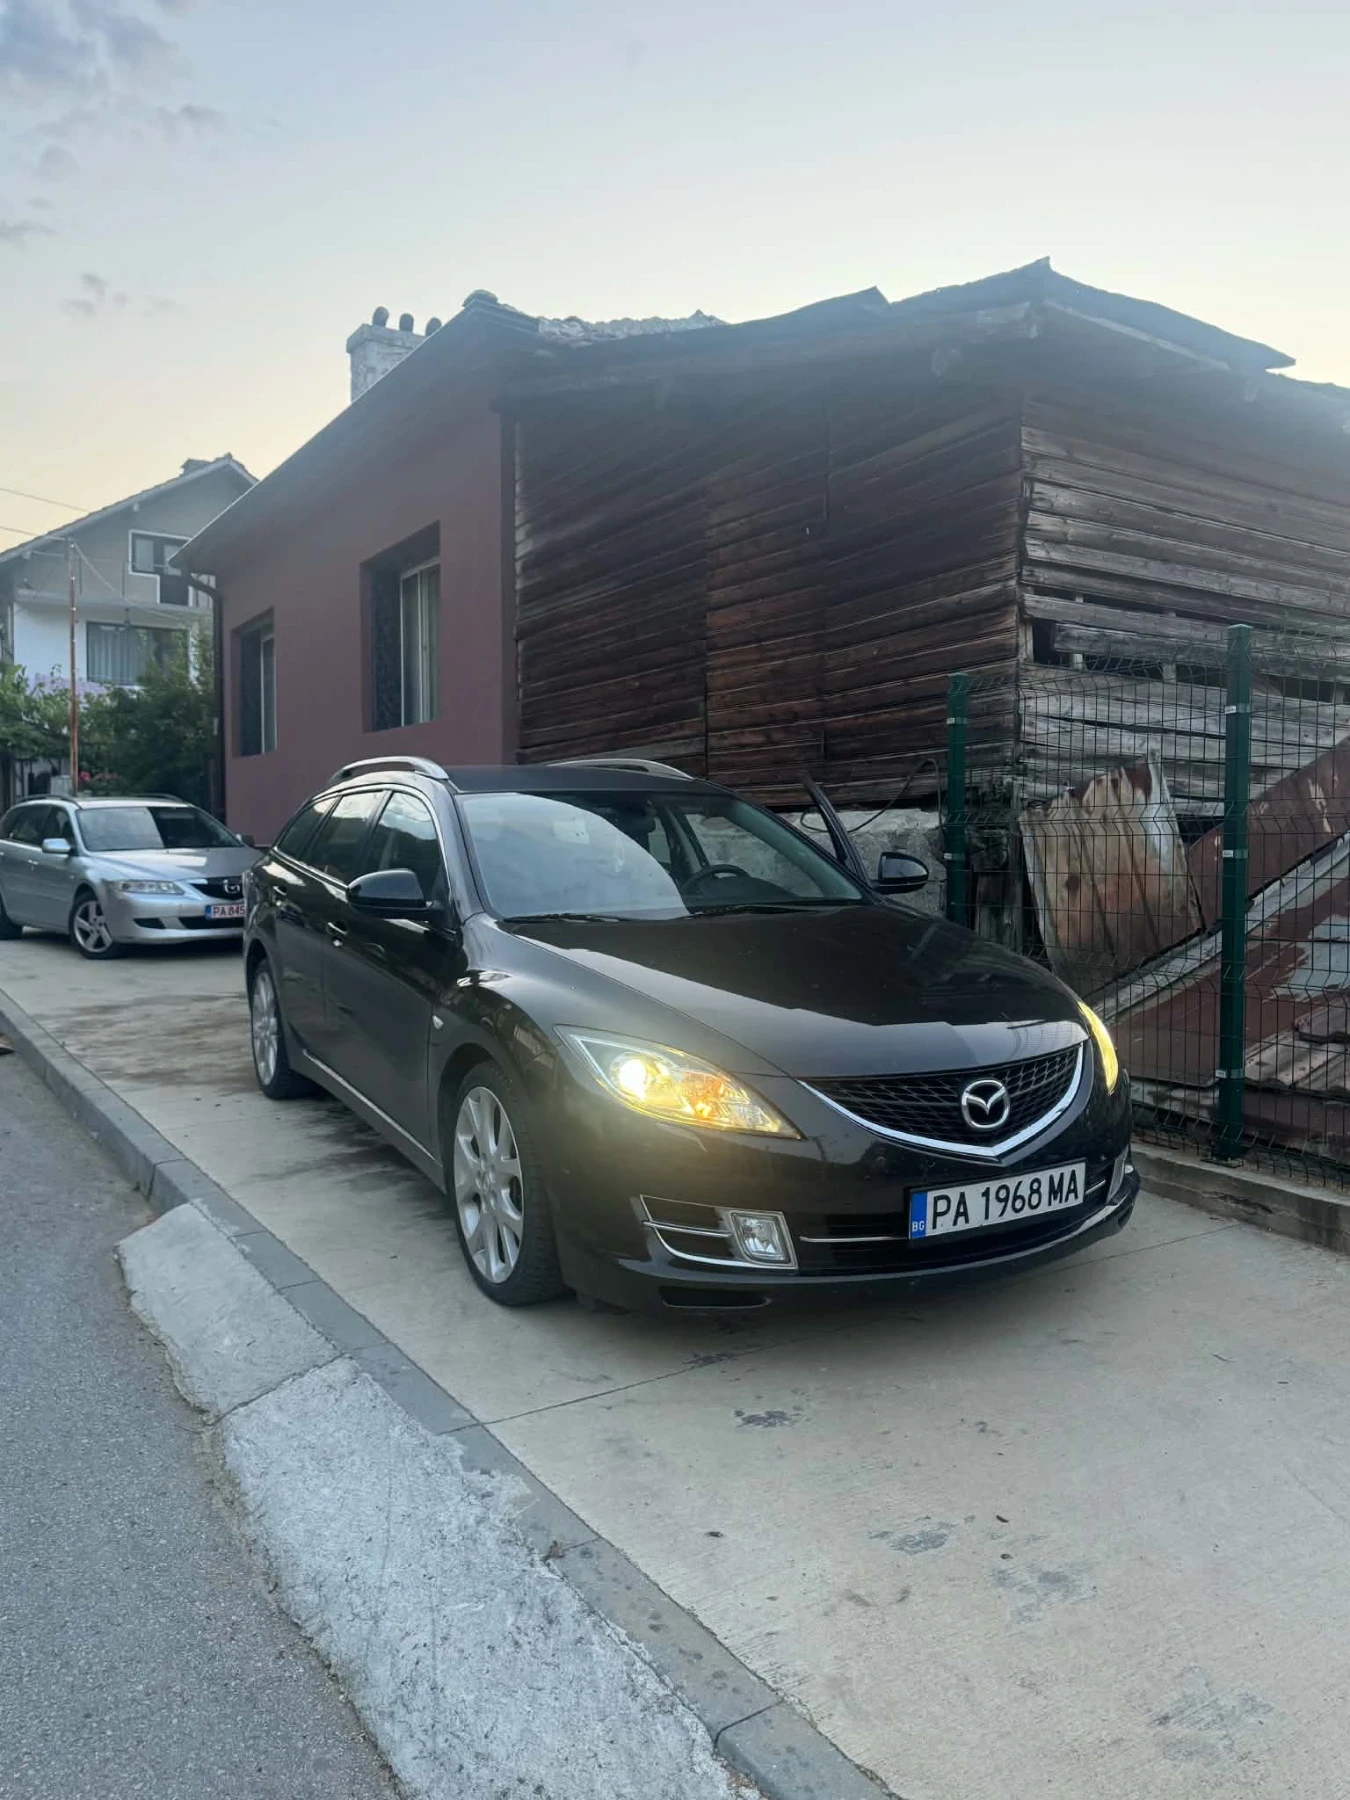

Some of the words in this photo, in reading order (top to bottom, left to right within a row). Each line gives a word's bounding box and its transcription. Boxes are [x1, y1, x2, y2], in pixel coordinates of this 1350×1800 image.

[932, 1192, 969, 1230] PA
[981, 1178, 1042, 1220] 1968
[1048, 1170, 1079, 1206] MA
[912, 1221, 926, 1232] BG
